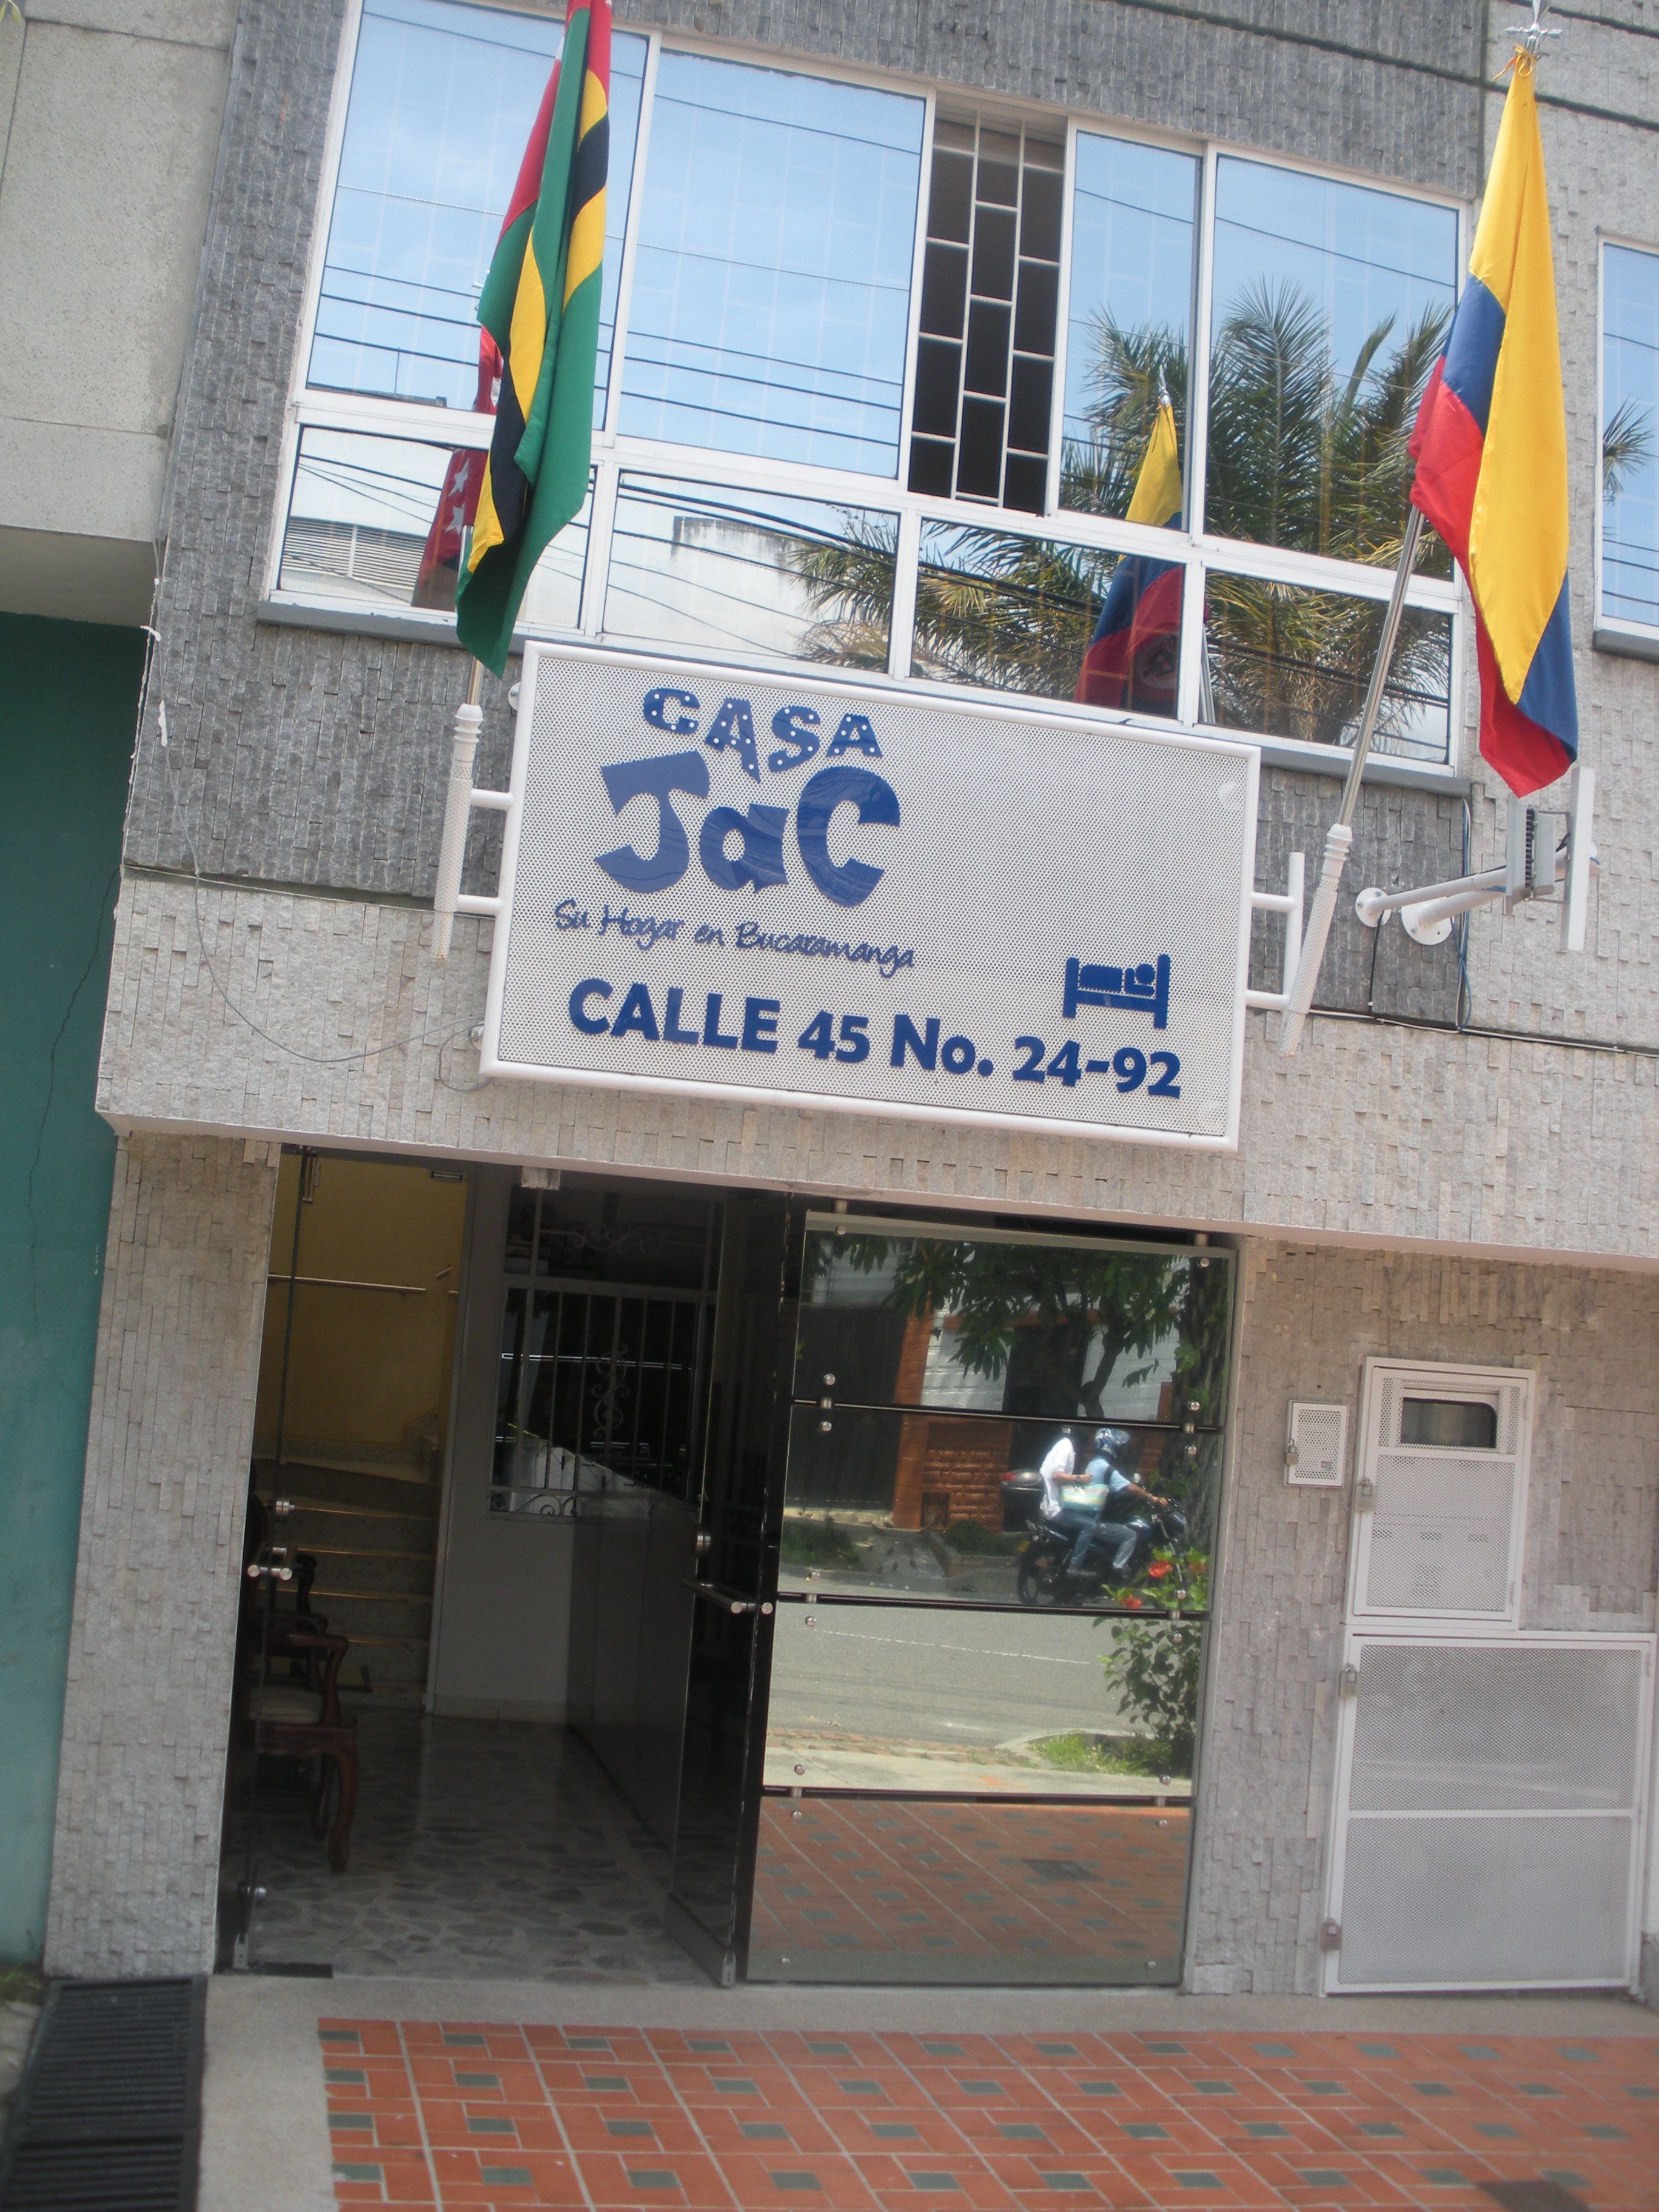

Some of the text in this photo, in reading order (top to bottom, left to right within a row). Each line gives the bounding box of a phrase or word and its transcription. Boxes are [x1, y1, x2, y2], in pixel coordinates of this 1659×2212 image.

[643, 686, 882, 782] CASA
[554, 897, 915, 978] Su Hogar en Bucaramanga
[568, 977, 1181, 1098] CALLE 45 No. 24-92
